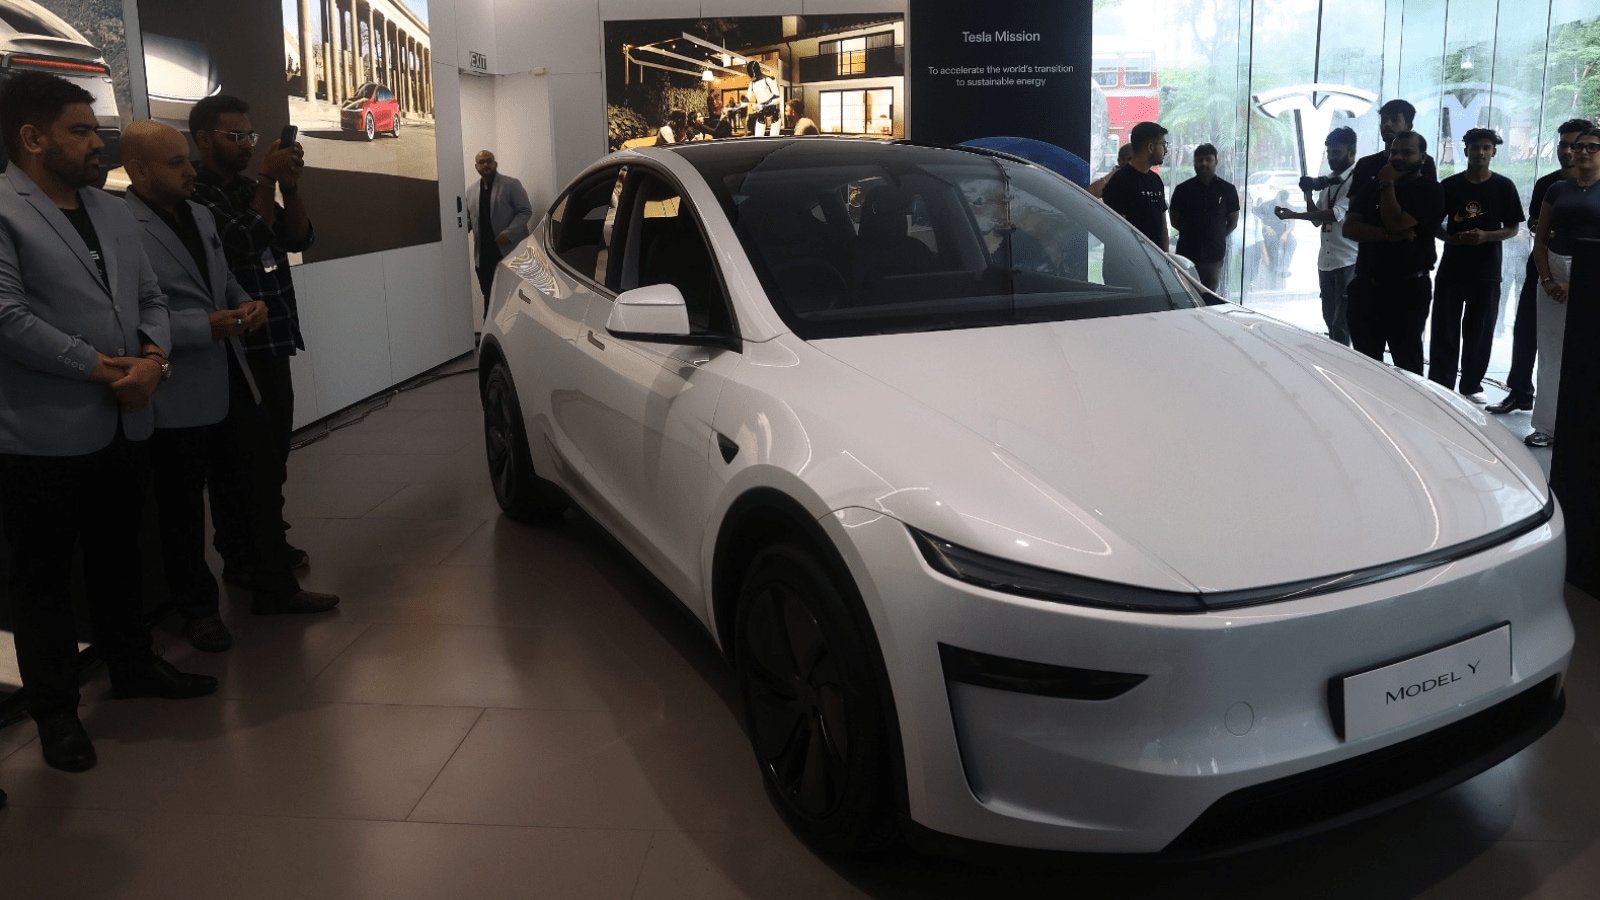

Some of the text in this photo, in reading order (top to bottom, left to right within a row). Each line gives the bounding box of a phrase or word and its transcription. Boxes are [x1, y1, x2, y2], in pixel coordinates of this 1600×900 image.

[962, 30, 1041, 43] Tesla Mission
[470, 52, 487, 70] EXIT
[928, 66, 939, 75] To
[940, 65, 985, 75] accelerate
[986, 65, 1001, 74] the
[1034, 64, 1074, 73] transition
[956, 77, 1047, 88] to sustainable energy
[1386, 660, 1480, 705] MODEL Y
